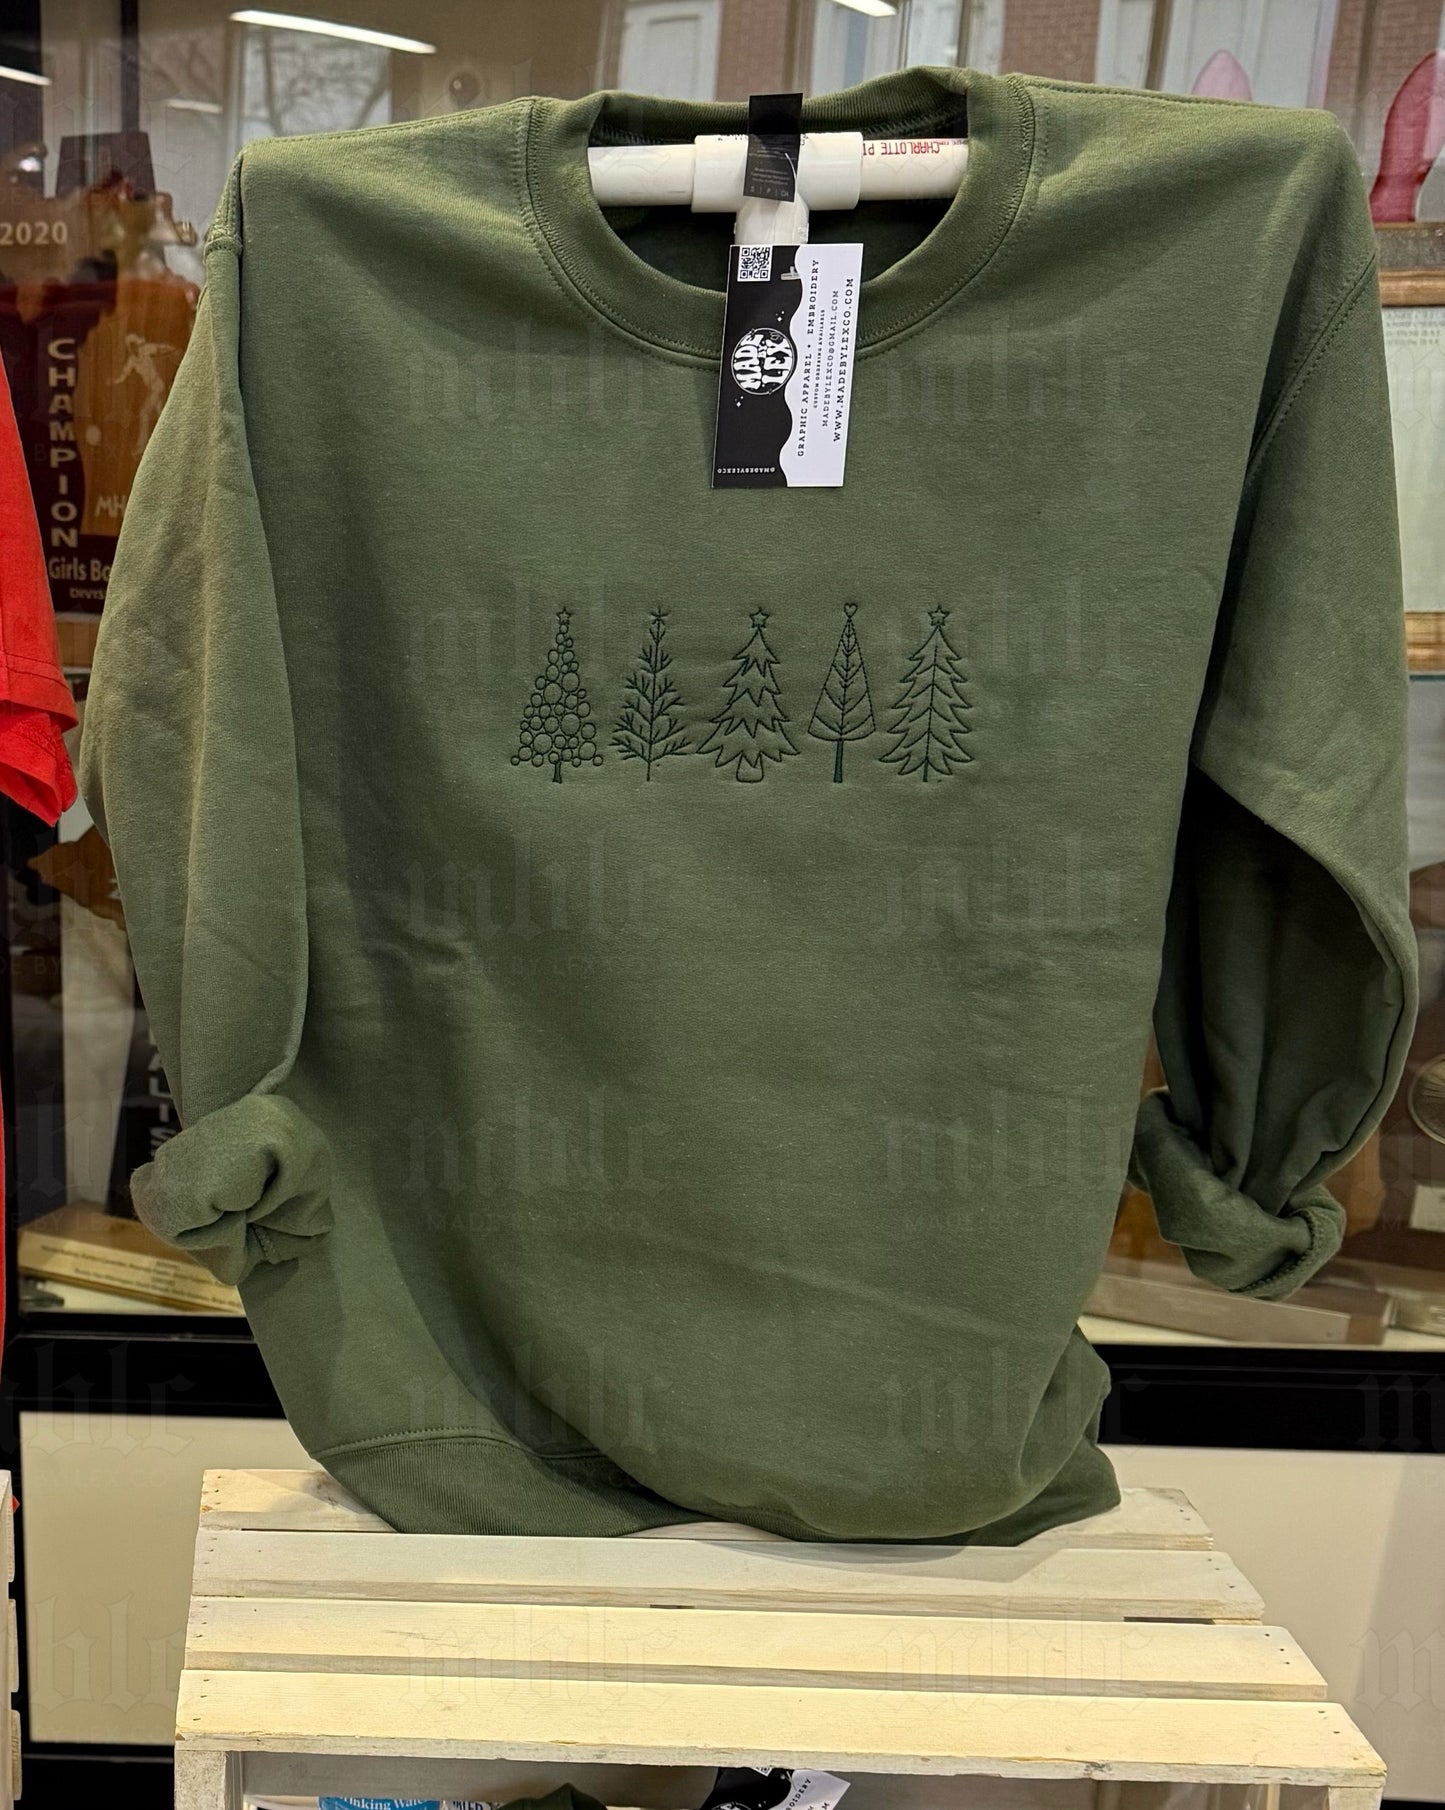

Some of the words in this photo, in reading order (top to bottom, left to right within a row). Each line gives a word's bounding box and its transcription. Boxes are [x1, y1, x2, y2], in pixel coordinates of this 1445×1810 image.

[881, 141, 940, 155] CHARLOTTE
[0, 221, 68, 246] 2020
[807, 259, 819, 335] EMBROIDERY
[733, 334, 764, 389] MADE
[762, 338, 792, 385] LEX
[801, 353, 812, 403] APPAREL
[822, 289, 839, 427] MADEBYLEXCO@GMAIL.COM
[833, 278, 854, 442] WWW.MADEBYLEXCO.COM
[47, 338, 79, 548] CHAMPION
[797, 408, 808, 457] GRAPHIC
[48, 557, 88, 581] Girls
